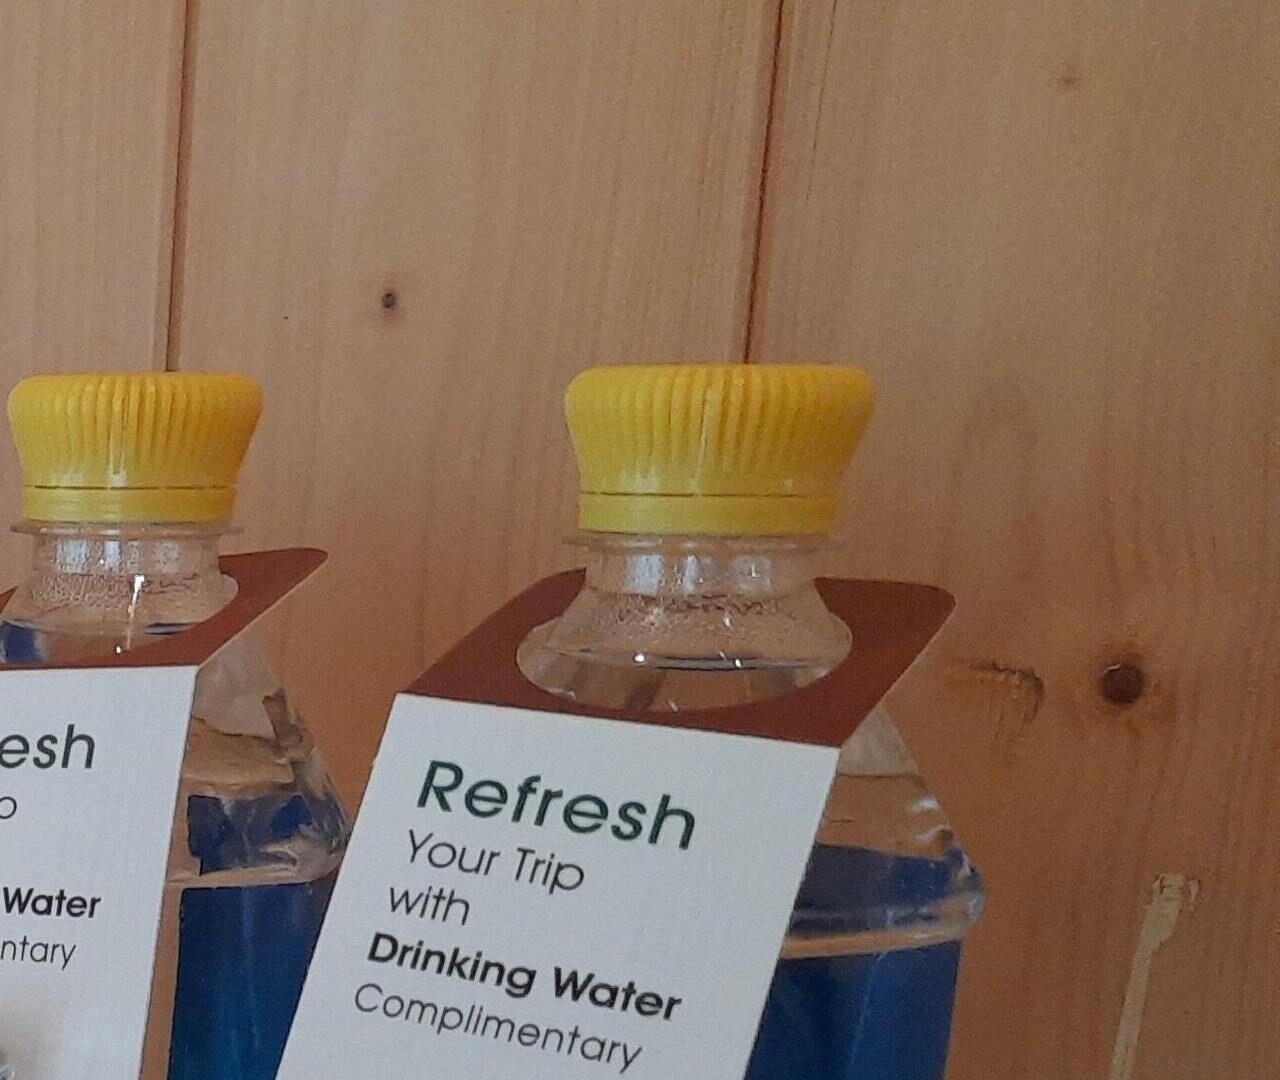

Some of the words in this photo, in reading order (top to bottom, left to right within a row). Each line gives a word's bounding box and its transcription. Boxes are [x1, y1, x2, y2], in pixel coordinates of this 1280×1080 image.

[415, 759, 696, 851] Refresh
[407, 828, 501, 878] Your
[512, 846, 585, 895] Trip
[2, 886, 102, 920] Water
[389, 883, 471, 927] with
[367, 932, 537, 999] Drinking
[552, 966, 683, 1022] Water
[354, 982, 643, 1074] Complimentary
